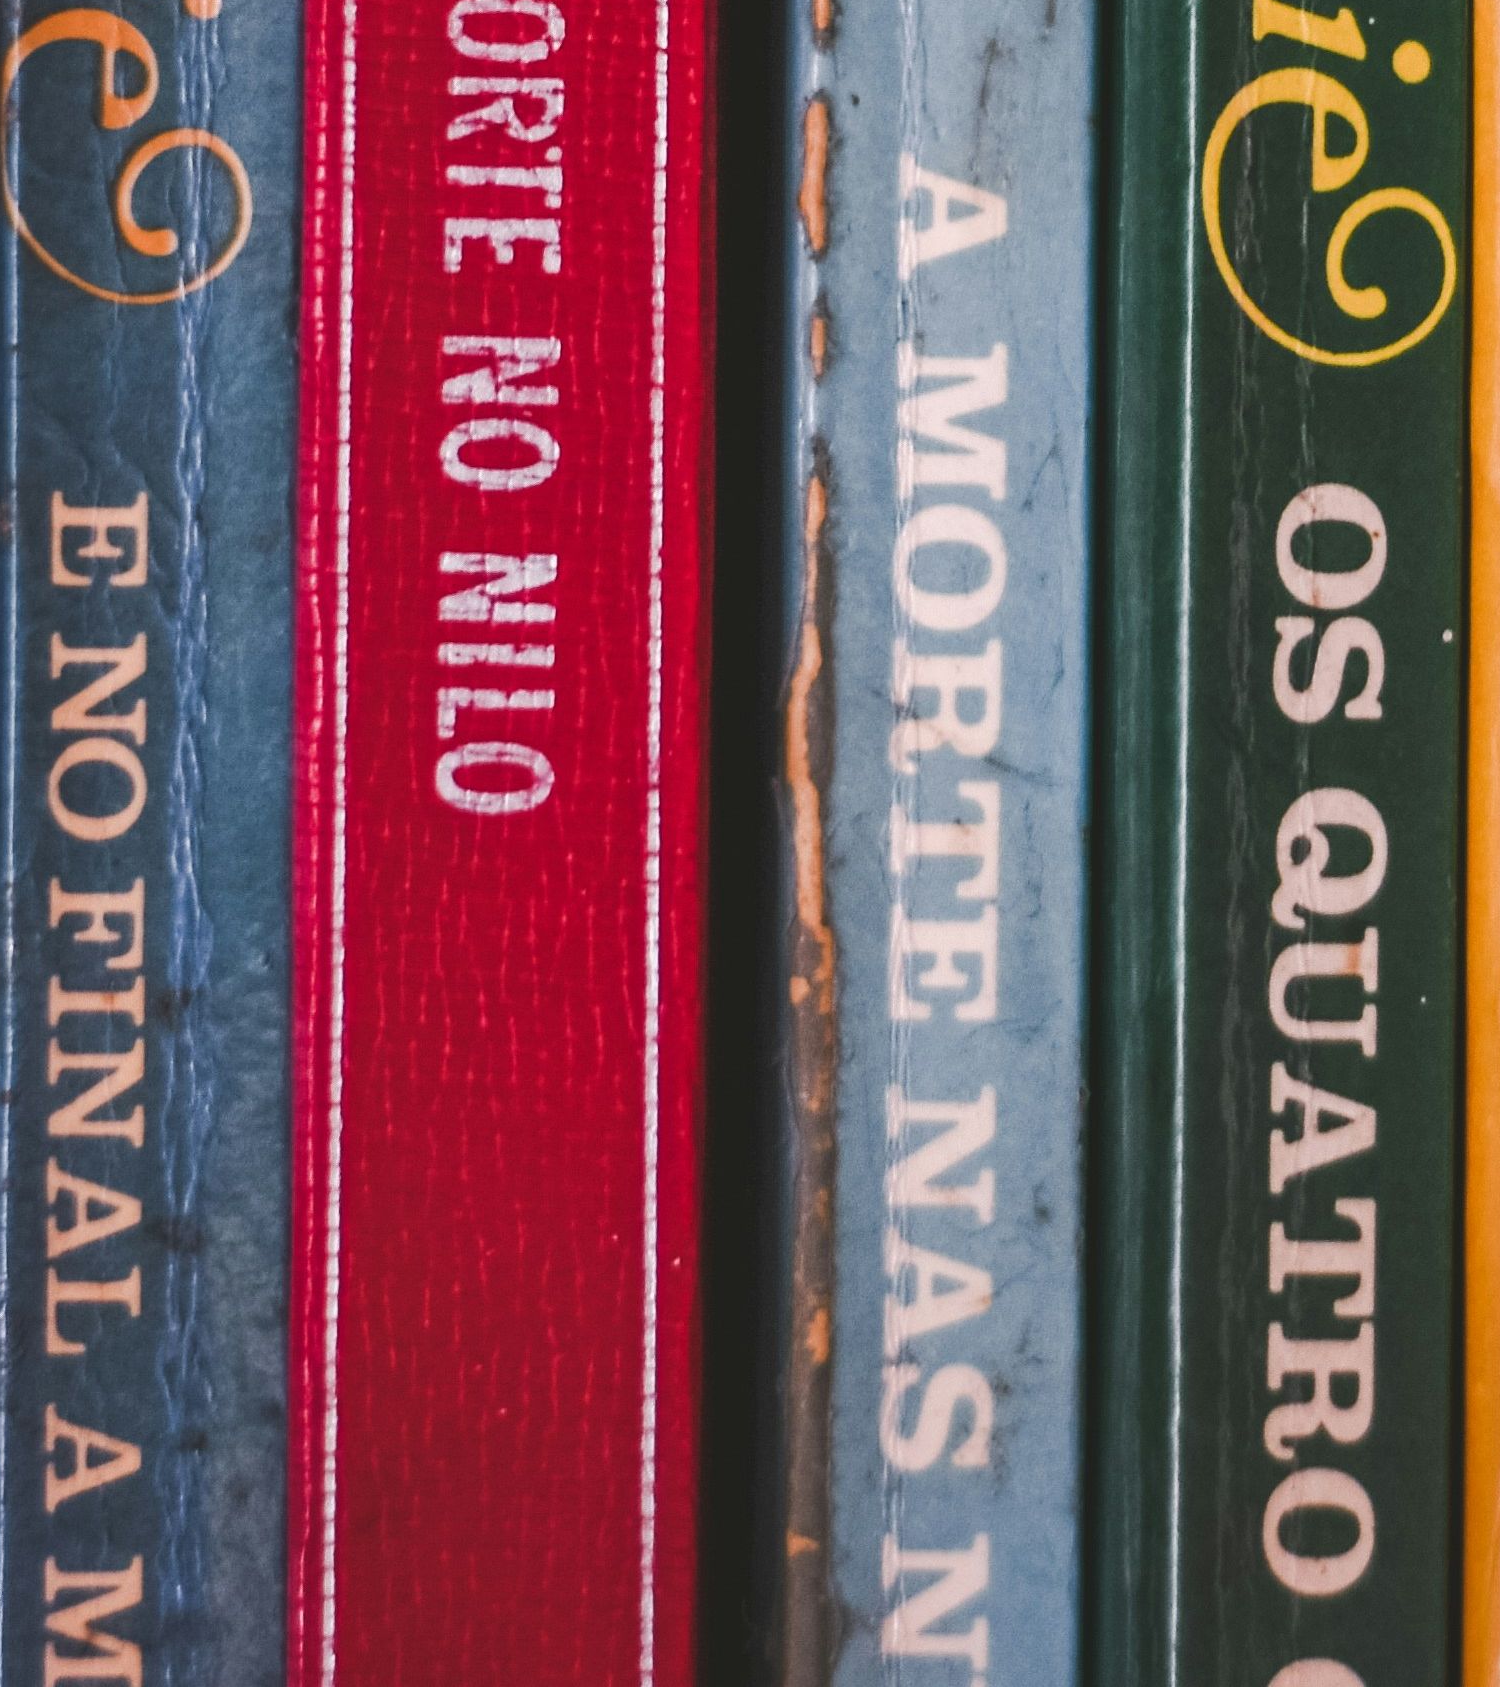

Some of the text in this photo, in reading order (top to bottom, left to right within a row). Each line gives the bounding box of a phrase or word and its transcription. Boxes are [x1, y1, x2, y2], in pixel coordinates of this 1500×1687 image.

[898, 155, 1009, 277] A
[437, 335, 561, 492] NO
[52, 493, 149, 587] E
[1272, 482, 1389, 726] OS
[48, 630, 149, 841] NO
[434, 553, 558, 816] NILO
[889, 339, 1010, 1026] MORTE
[45, 883, 146, 1357] FINAL
[1261, 786, 1389, 1600] QUATRO
[880, 1084, 999, 1483] NAS
[43, 1407, 145, 1514] A
